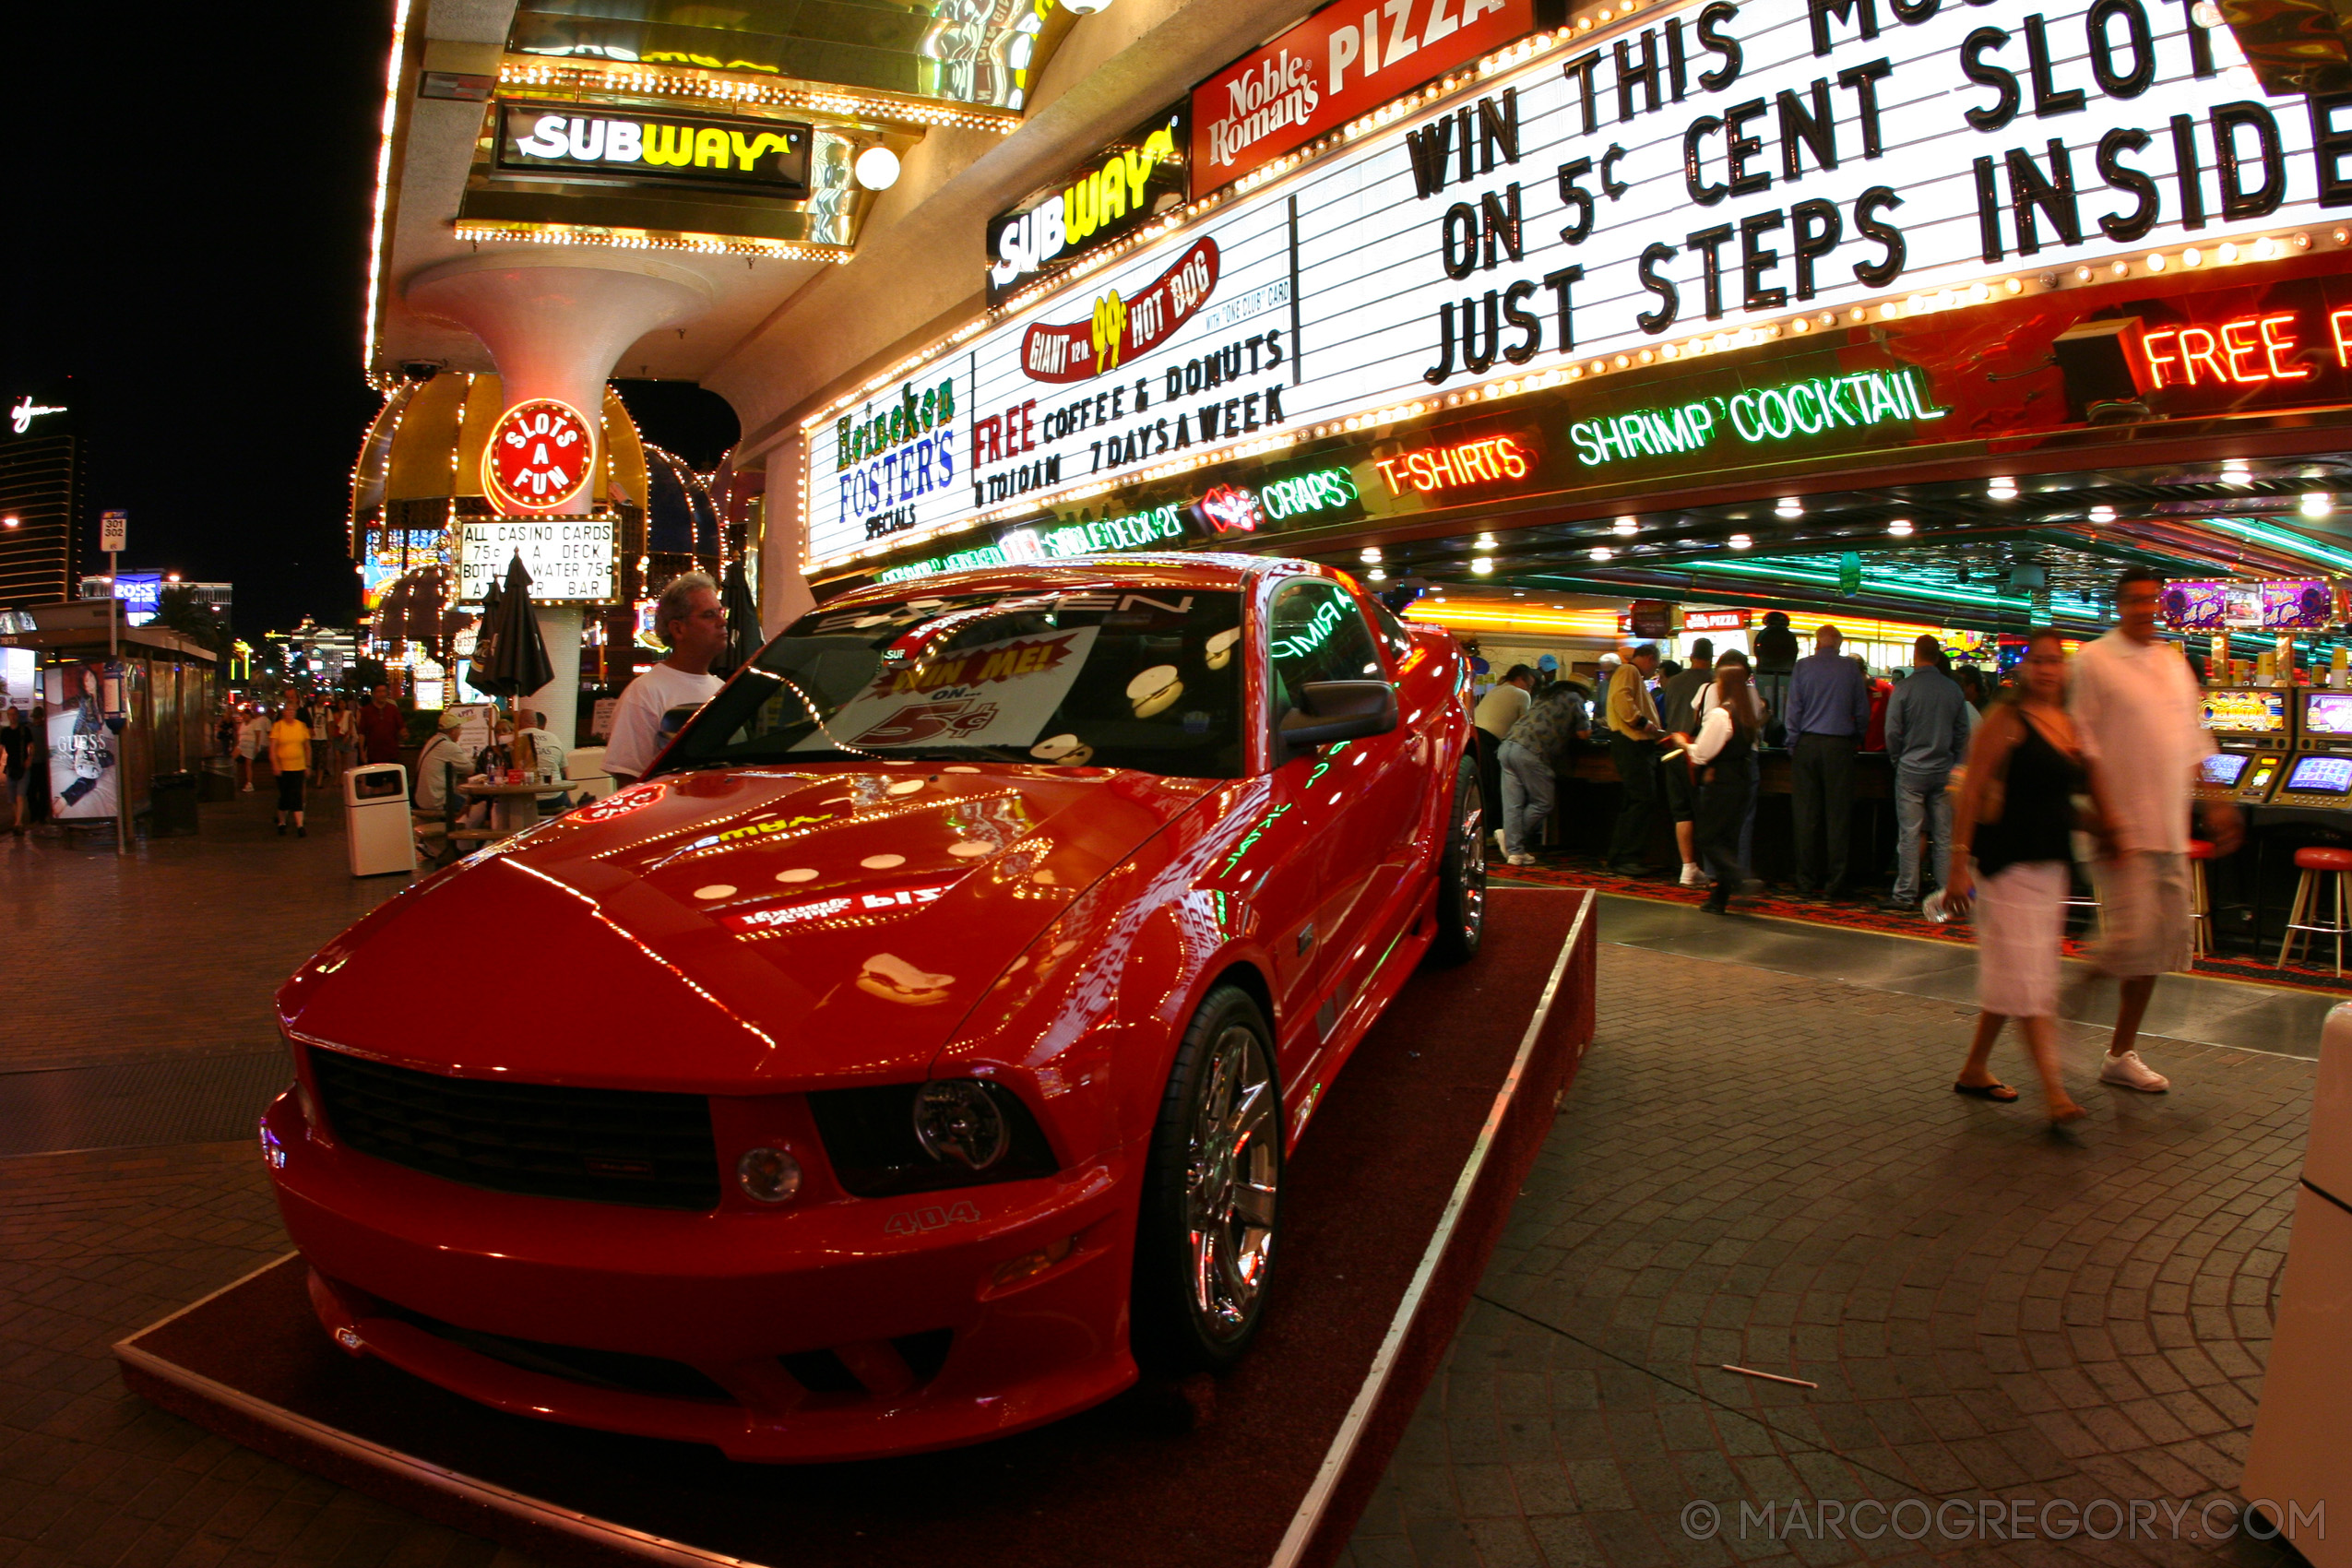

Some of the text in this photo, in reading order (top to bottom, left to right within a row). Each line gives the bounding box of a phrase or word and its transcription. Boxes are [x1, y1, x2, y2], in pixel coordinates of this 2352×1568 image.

[1226, 48, 1303, 122] Noble
[1406, 86, 1521, 200] WIN
[1563, 0, 1744, 136] THIS
[516, 115, 791, 172] SUBWAY
[1207, 75, 1319, 168] Roman's
[1443, 182, 1524, 281] ON
[1683, 56, 1894, 207] CENT
[991, 122, 1174, 291] SUBWAY
[1423, 92, 2352, 386] JUST STEPS INSIDE
[1028, 331, 1070, 374] GIANT
[1131, 289, 1164, 350] HOT
[1170, 250, 1210, 319] DOG
[1206, 312, 1220, 331] WITH
[1267, 280, 1289, 306] CARD
[2143, 315, 2309, 389] FREE
[972, 328, 1284, 469] FREE COFFEE & DONUTS
[1570, 371, 1945, 466] SHRIMP COCKTAIL
[505, 413, 578, 449] SLOTS
[837, 376, 956, 473] Heineken
[1108, 417, 1169, 474] DAYS
[1174, 413, 1192, 451] A
[1198, 384, 1285, 444] WEEK
[533, 443, 549, 465] A
[838, 429, 954, 524] FOSTER'S
[1376, 437, 1526, 495] T-SHIRTS
[513, 465, 570, 495] FUN
[1261, 471, 1348, 520] CRAPS
[104, 528, 124, 537] 302
[105, 519, 124, 529] 301
[464, 526, 612, 541] ALL CASINO CARDS
[1107, 510, 1158, 550] DECK
[532, 544, 541, 559] A
[563, 544, 600, 559] DECK
[532, 563, 579, 577] WATER
[568, 580, 600, 596] BAR
[813, 593, 1194, 634] SALEEN
[1709, 614, 1740, 626] PIZZA
[891, 645, 1054, 693] WIN ME!
[57, 733, 106, 752] GUESS
[884, 1201, 980, 1236] 404
